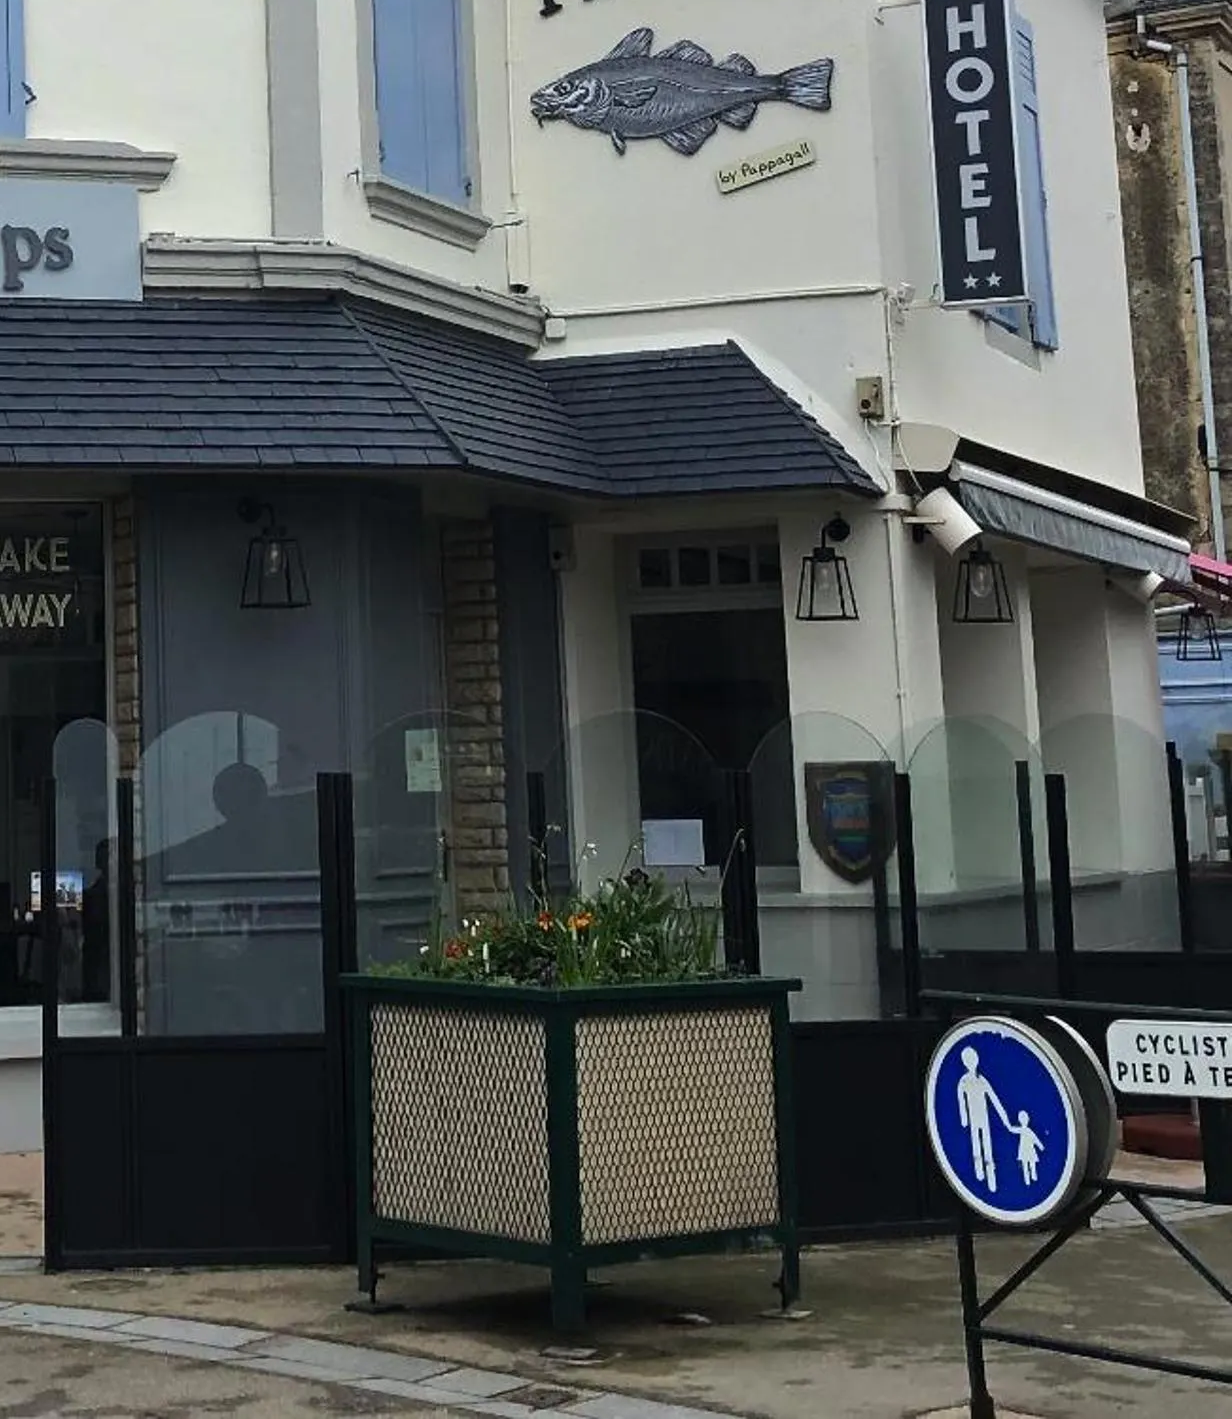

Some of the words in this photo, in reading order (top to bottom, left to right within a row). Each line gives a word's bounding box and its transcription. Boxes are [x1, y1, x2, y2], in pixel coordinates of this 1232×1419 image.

[945, 3, 996, 263] HOTEL
[1135, 1033, 1228, 1057] CYCLIST
[1116, 1061, 1171, 1084] PIED
